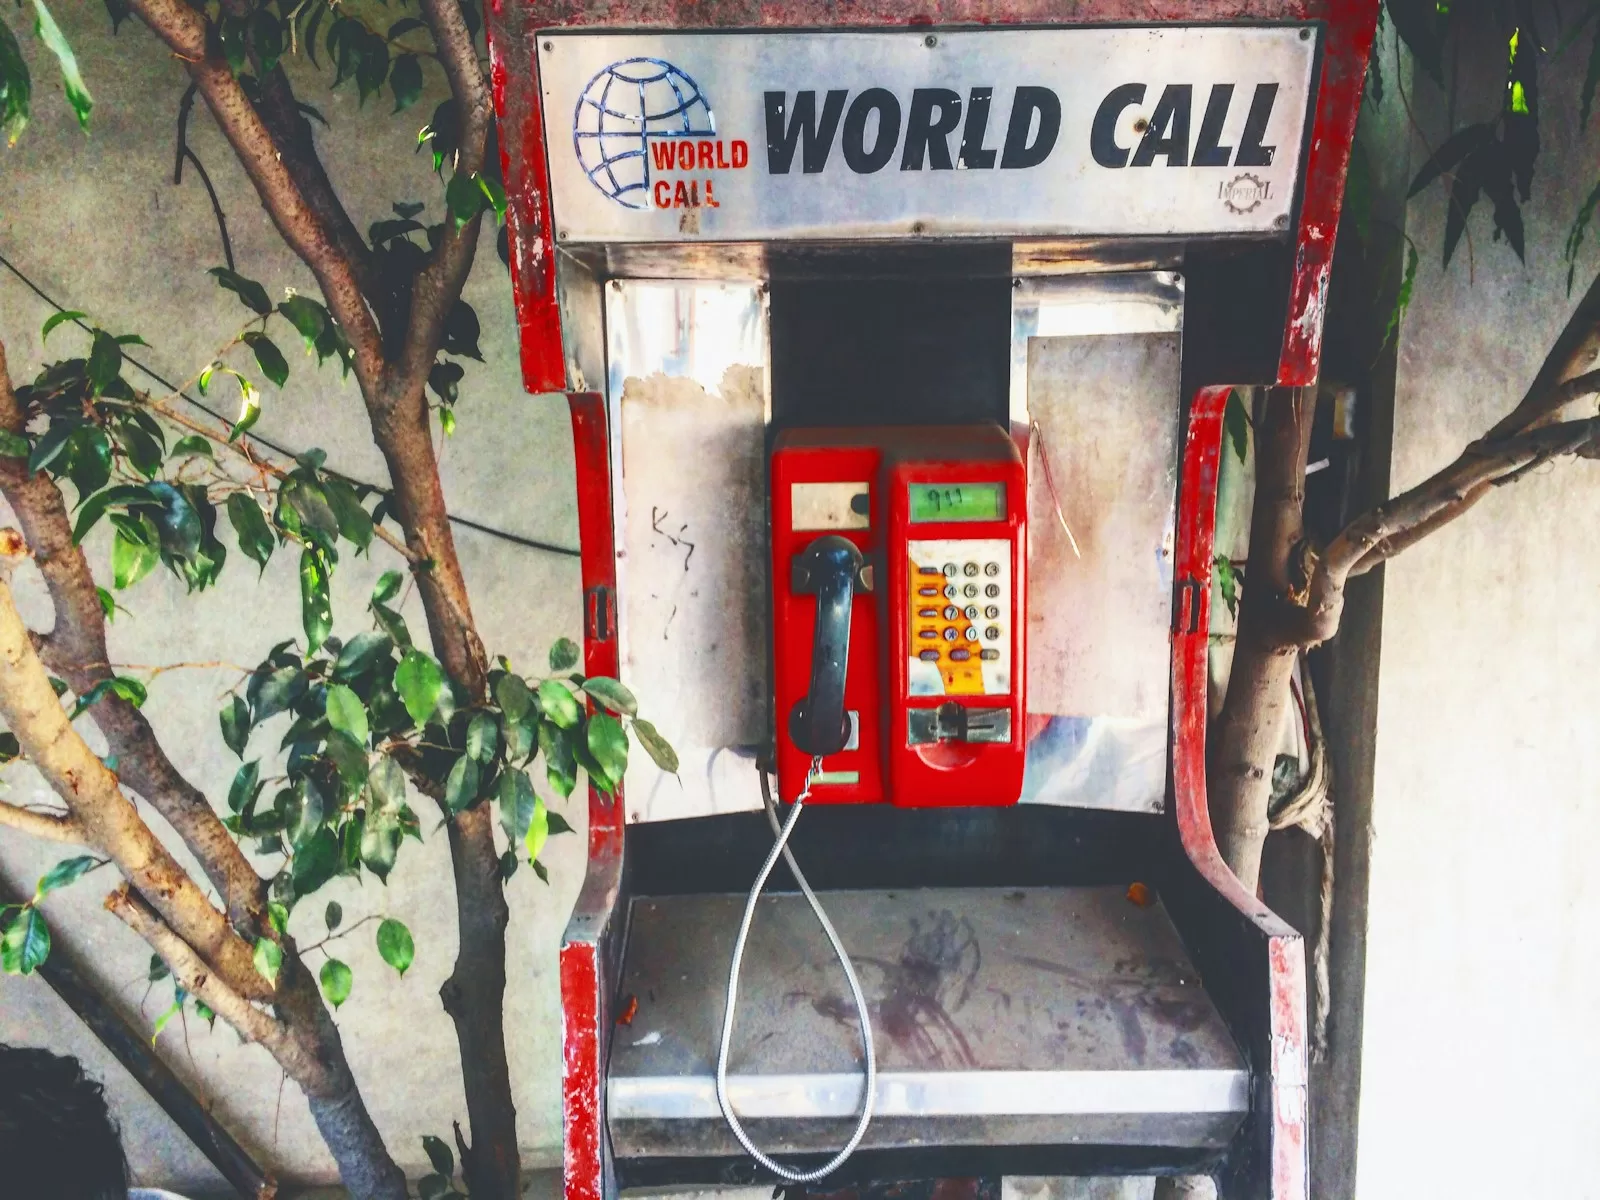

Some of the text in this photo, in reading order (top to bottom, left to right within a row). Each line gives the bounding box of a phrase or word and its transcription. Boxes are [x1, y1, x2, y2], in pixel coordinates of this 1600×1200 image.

[763, 82, 1280, 175] WORLD CALL
[651, 140, 748, 171] WORLD
[654, 179, 720, 209] CALL
